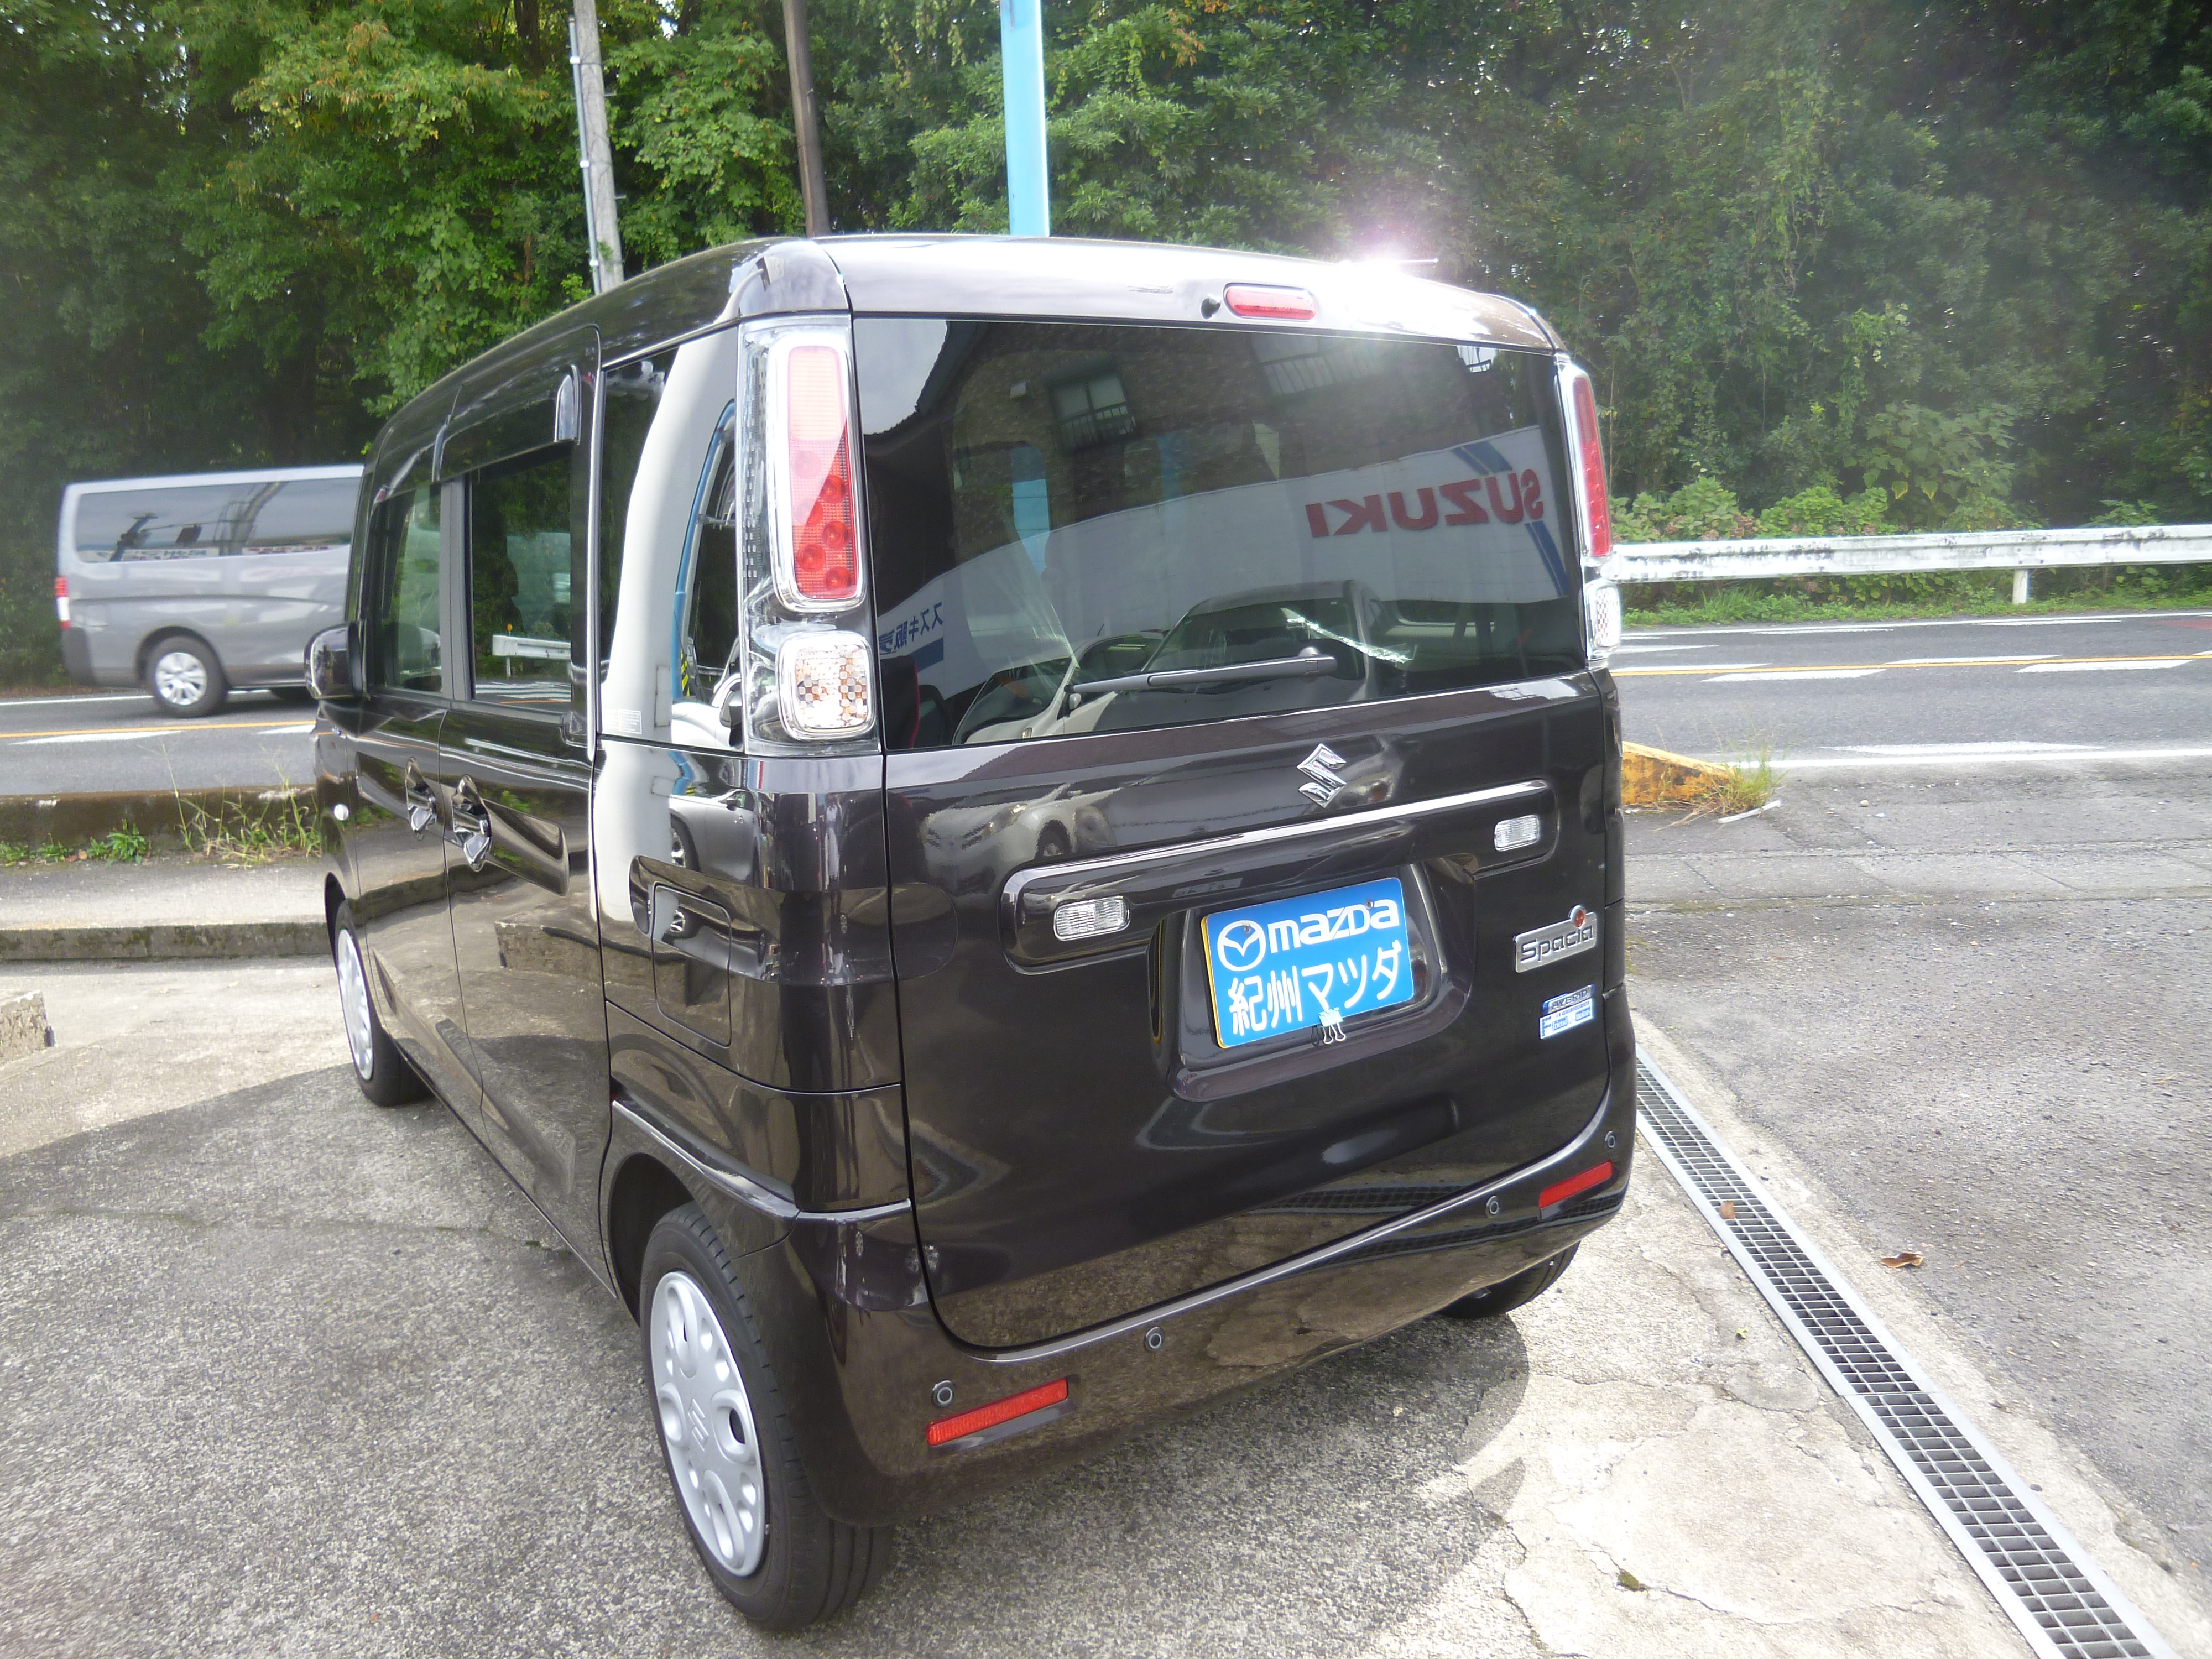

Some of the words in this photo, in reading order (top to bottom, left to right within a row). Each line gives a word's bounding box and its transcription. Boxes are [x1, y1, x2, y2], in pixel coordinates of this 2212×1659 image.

[1520, 910, 1594, 963] Spacia
[1228, 940, 1402, 1036] 紀州マツダ
[1552, 990, 1588, 1009] HYBRID
